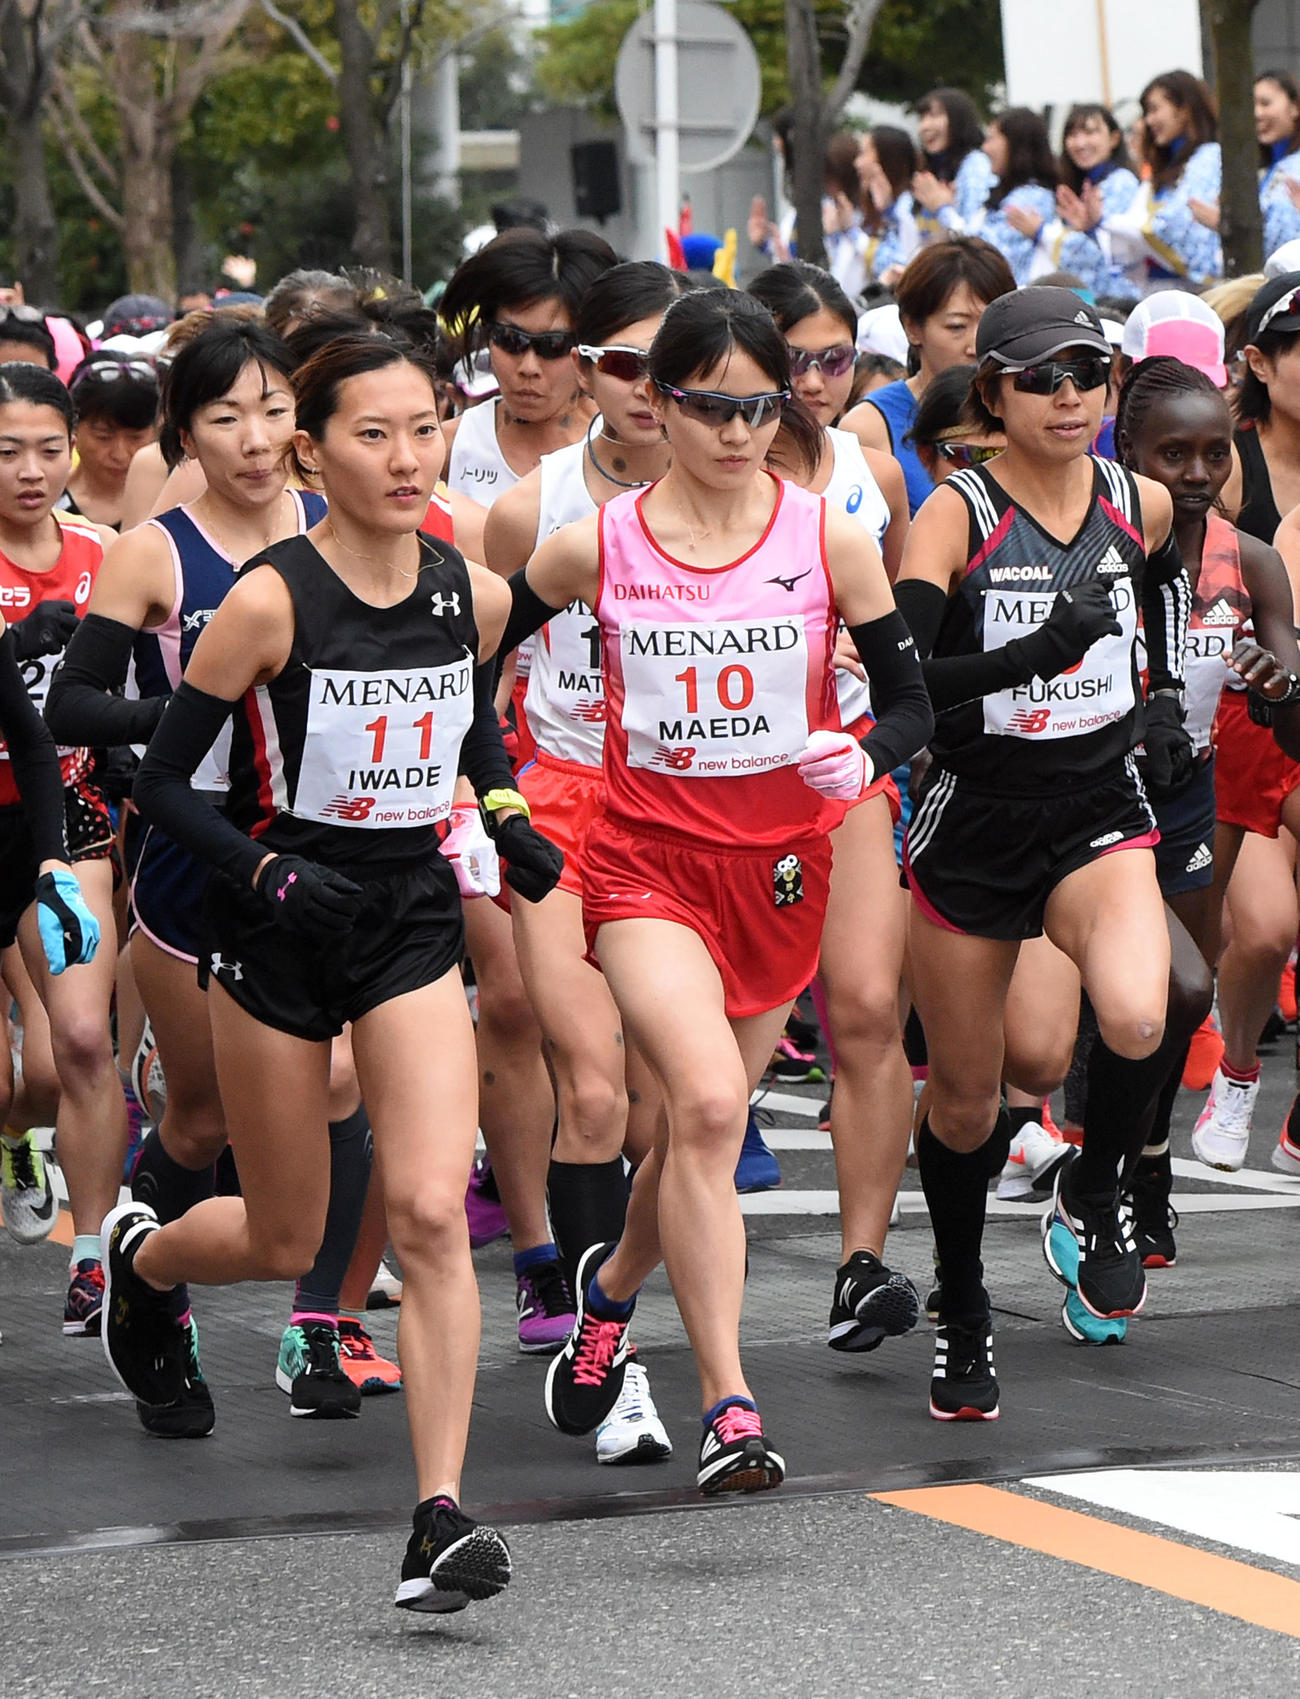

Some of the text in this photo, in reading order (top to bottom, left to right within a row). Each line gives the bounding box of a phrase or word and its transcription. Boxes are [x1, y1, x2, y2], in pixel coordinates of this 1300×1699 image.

[460, 467, 498, 485] ノーリツ
[989, 565, 1053, 583] WACOAL
[1096, 562, 1129, 574] adidas
[614, 583, 710, 601] DAIHATSU
[1202, 615, 1240, 625] adidas
[628, 624, 799, 657] MENARD
[319, 667, 470, 706] MENARD
[675, 664, 755, 714] 10
[1012, 674, 1113, 703] FUKUSHI
[659, 715, 771, 741] MAEDA
[1052, 720, 1076, 732] new
[1079, 710, 1121, 729] balance
[365, 711, 434, 764] 11
[698, 759, 727, 771] new
[731, 752, 789, 769] balance
[348, 765, 442, 791] IWADE
[375, 811, 404, 822] new
[407, 800, 450, 821] balance
[1185, 855, 1213, 873] adidas
